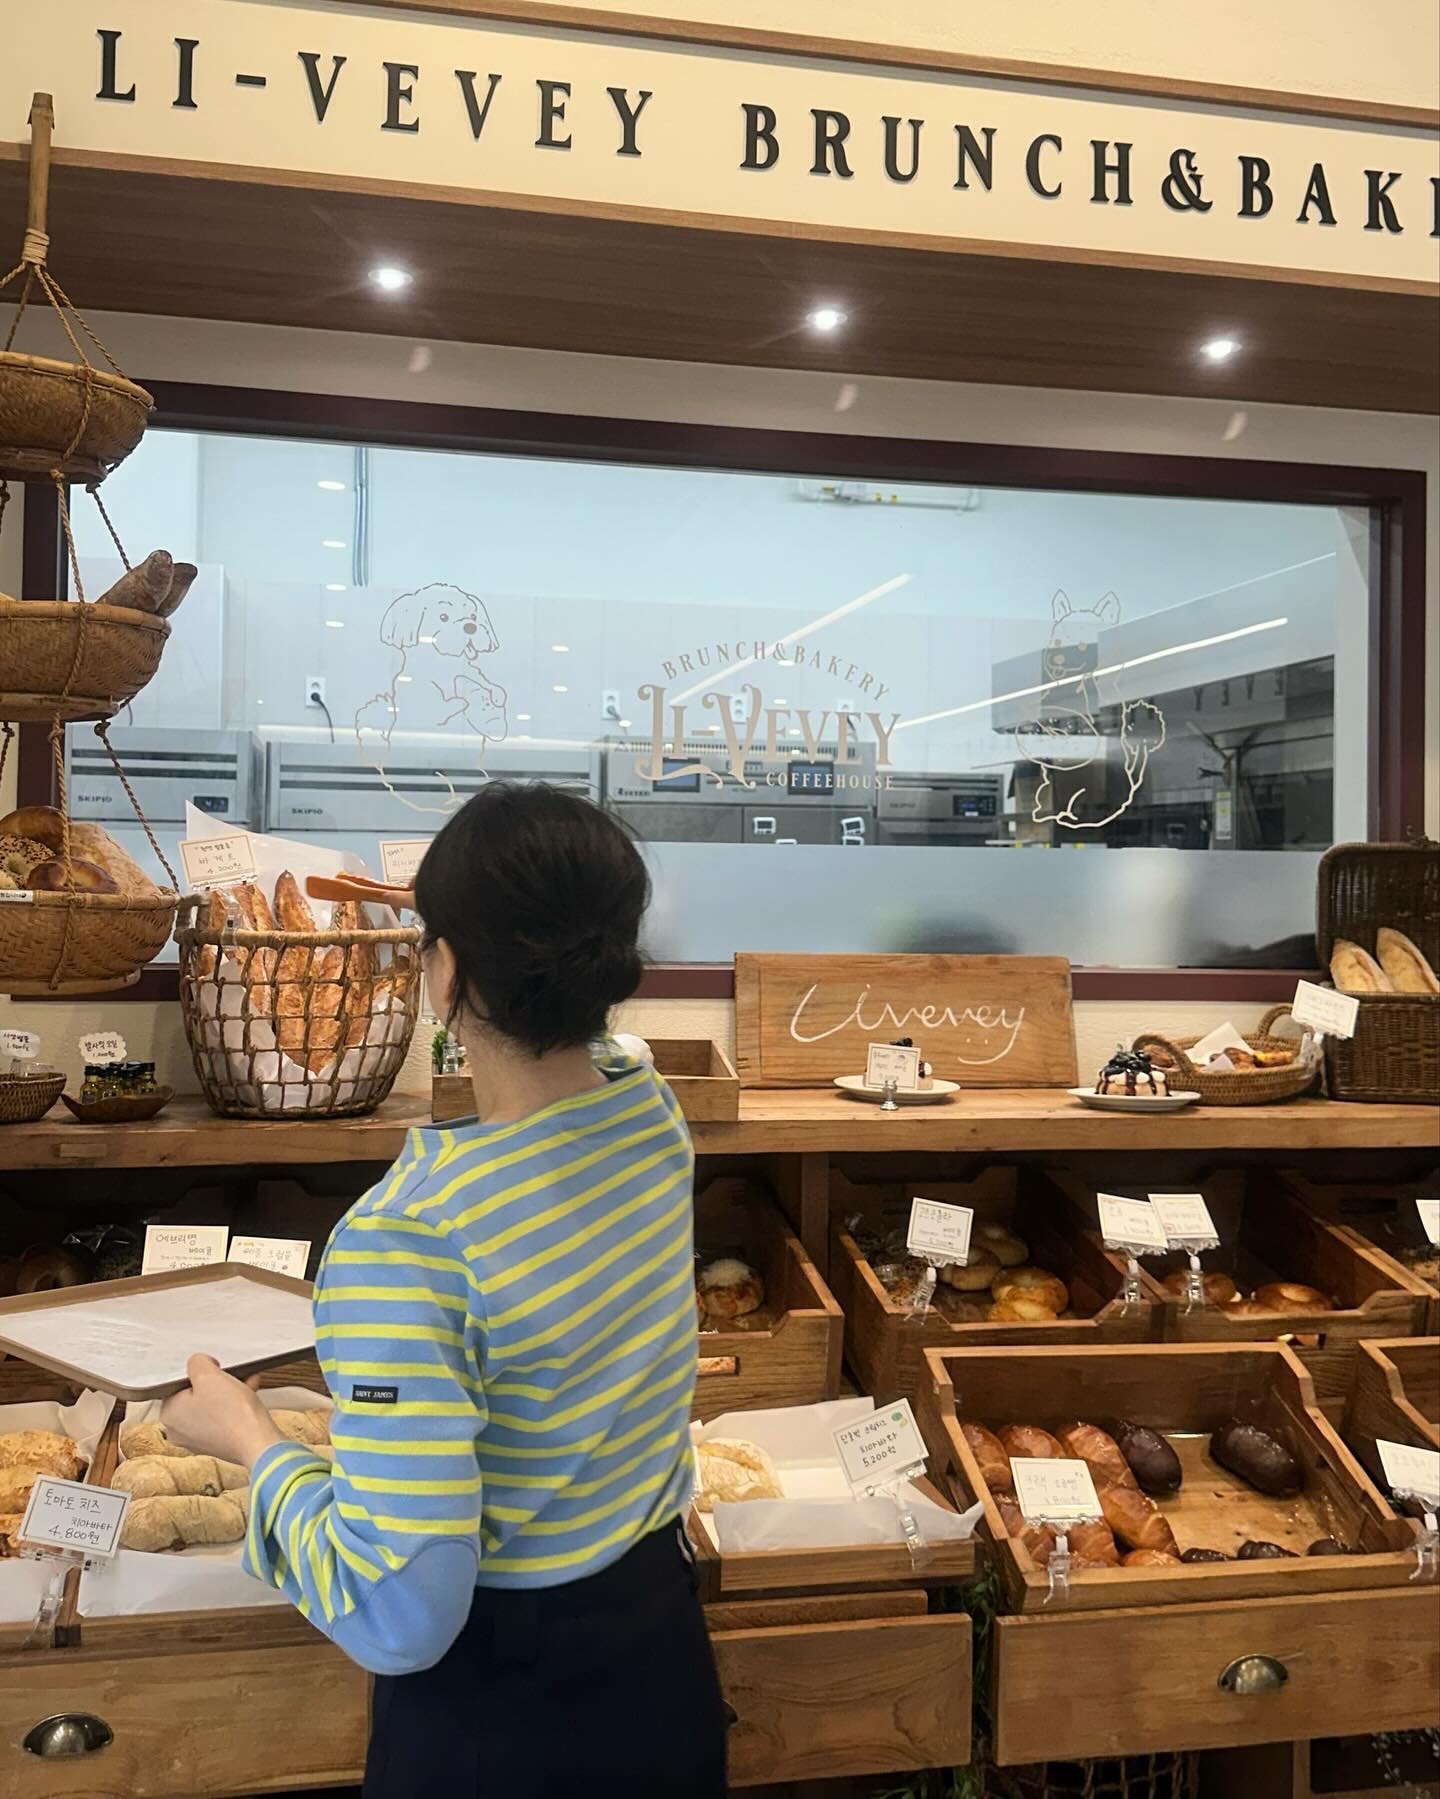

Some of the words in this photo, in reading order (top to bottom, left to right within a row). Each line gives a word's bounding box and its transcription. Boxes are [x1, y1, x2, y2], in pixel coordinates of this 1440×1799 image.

[95, 28, 653, 157] LI-VEVEY
[739, 103, 1440, 238] BRUNCH&BAK
[661, 641, 890, 702] BRUNCH&BAKERY
[765, 771, 894, 791] COFFEEHOUSE
[789, 983, 1025, 1065] Livevey
[43, 1488, 75, 1511] 토마토
[79, 1497, 102, 1514] 치즈
[71, 1516, 114, 1531] 치아바타
